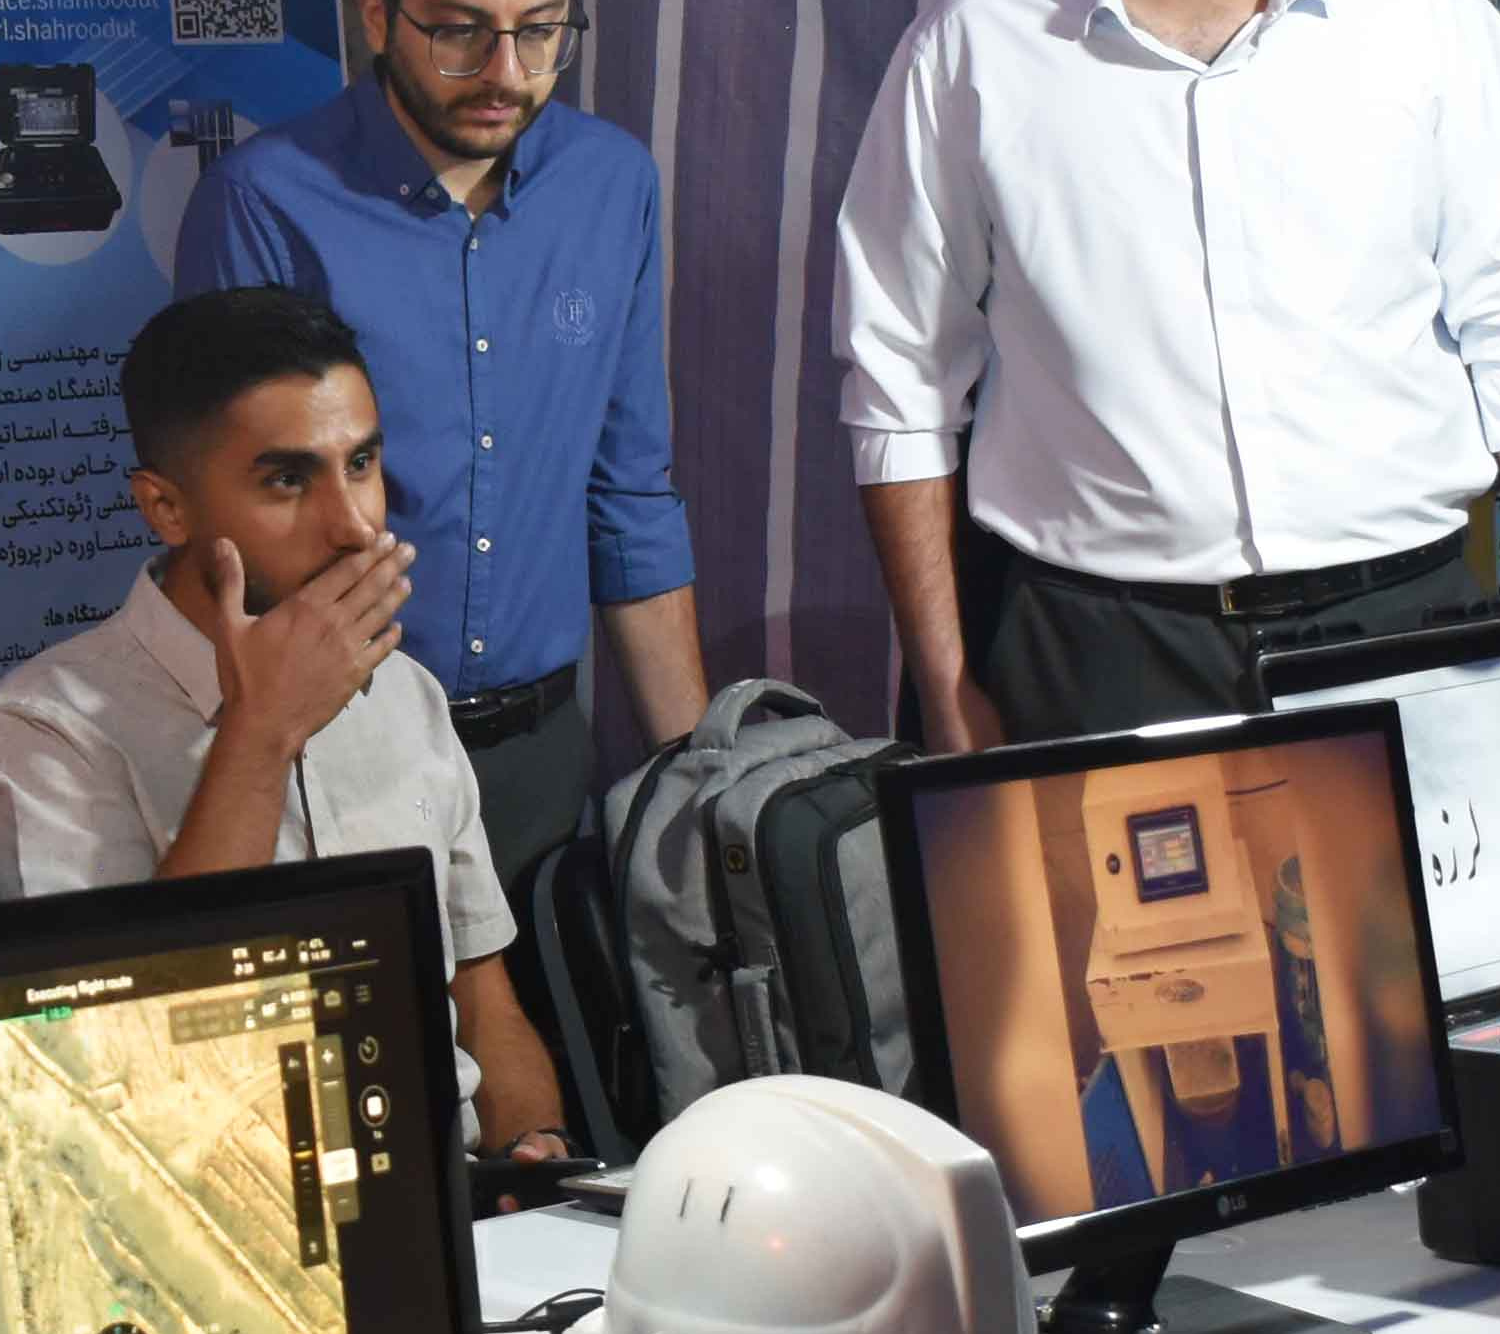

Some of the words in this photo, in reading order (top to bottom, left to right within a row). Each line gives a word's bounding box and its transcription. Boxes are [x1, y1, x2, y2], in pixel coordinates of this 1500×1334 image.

[7, 342, 99, 373] مهندسی
[14, 464, 56, 488] بوده
[60, 453, 119, 486] خاص
[1, 492, 94, 529] ژئوتکنیکی
[44, 539, 63, 564] در
[68, 531, 144, 561] مشاوره
